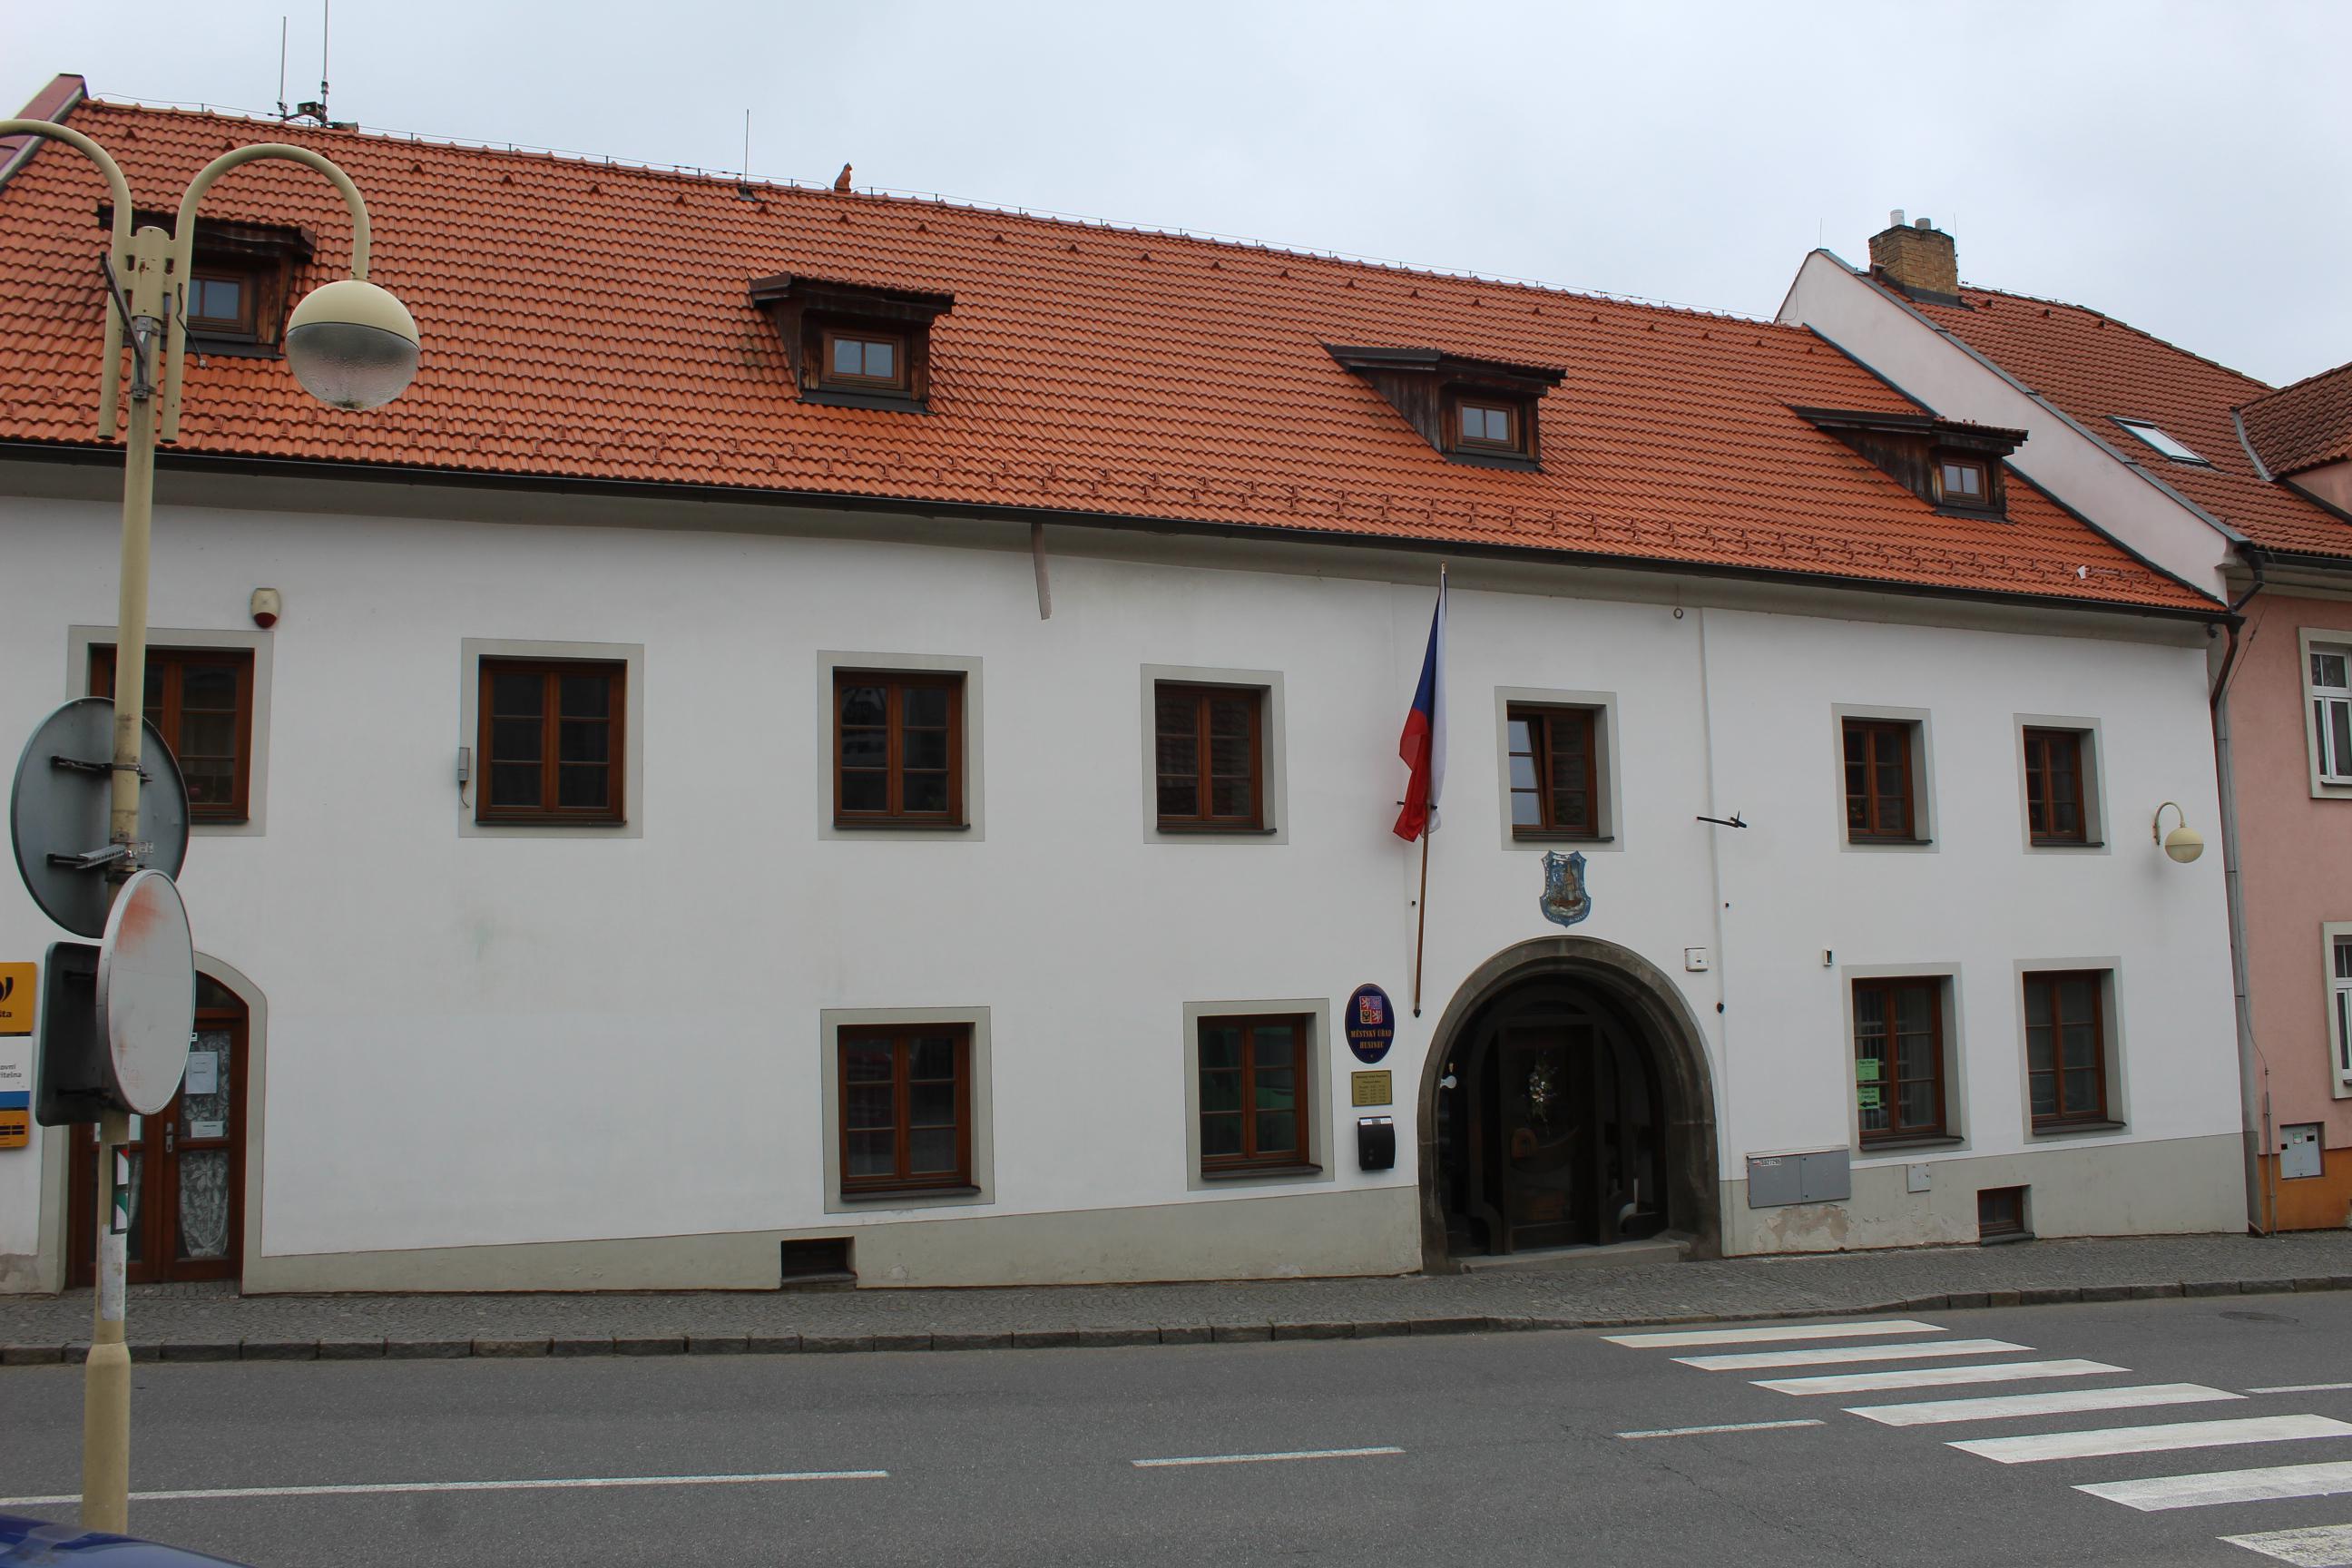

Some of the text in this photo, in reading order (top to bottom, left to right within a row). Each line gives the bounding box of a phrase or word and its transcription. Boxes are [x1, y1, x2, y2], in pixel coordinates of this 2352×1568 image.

[1350, 1028, 1392, 1037] MĚSTSKÝ ÚŘAD
[1359, 1041, 1385, 1049] HUSINEC
